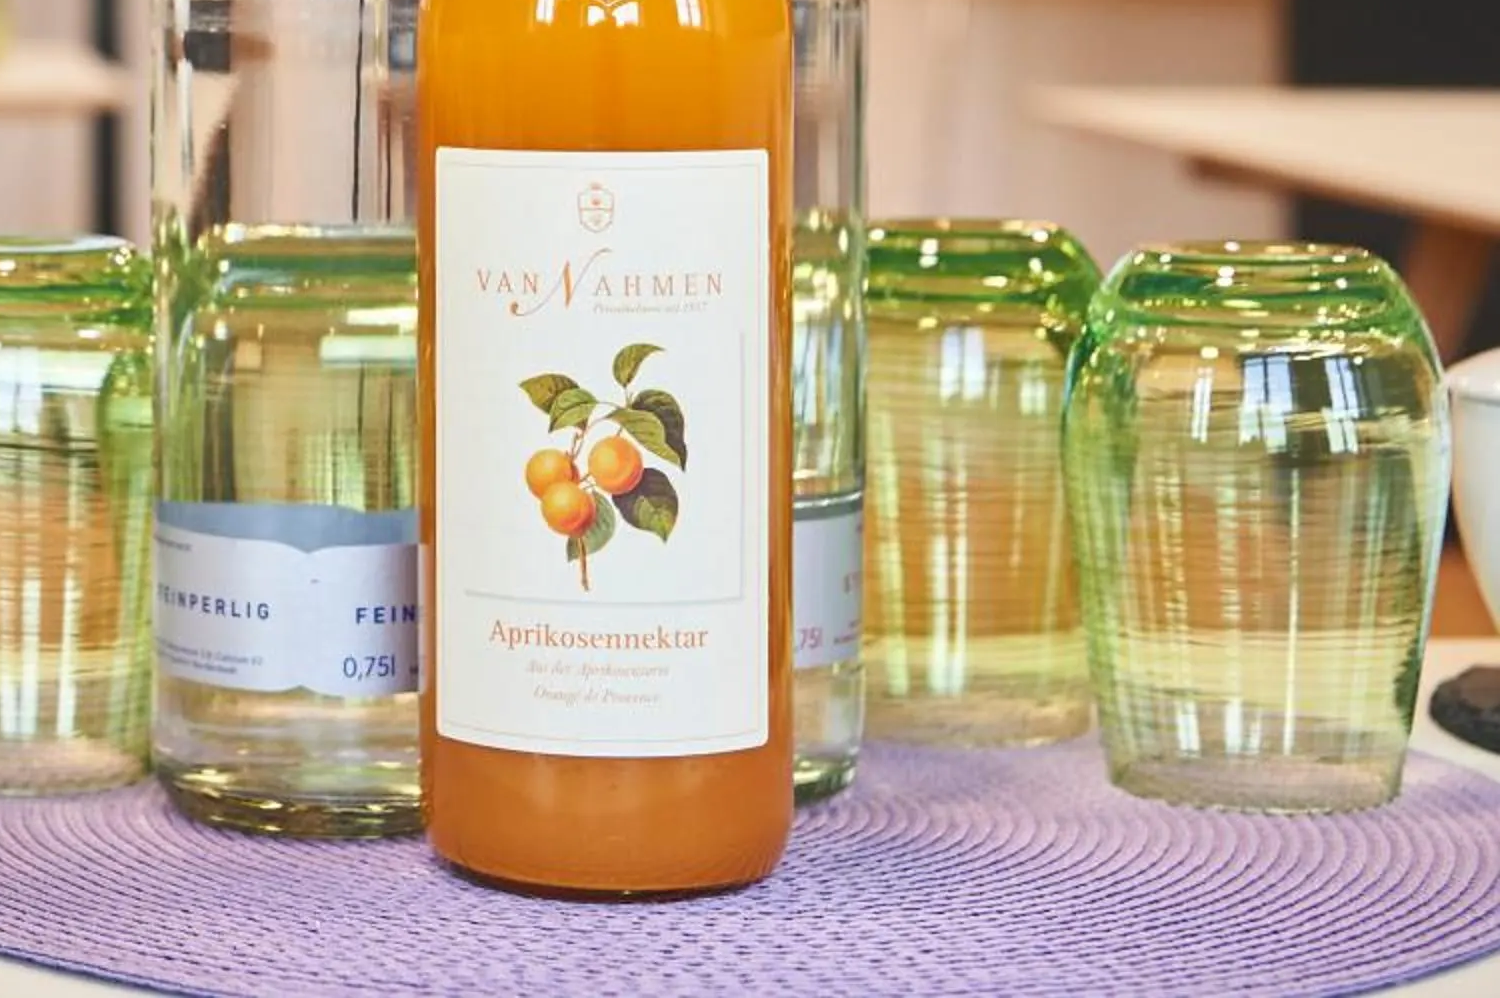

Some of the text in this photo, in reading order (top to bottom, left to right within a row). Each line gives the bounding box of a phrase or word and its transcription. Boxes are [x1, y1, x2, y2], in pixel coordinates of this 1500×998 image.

[475, 267, 540, 296] VAN
[489, 619, 709, 651] Aprikosennektar
[342, 654, 397, 682] 0,75l
